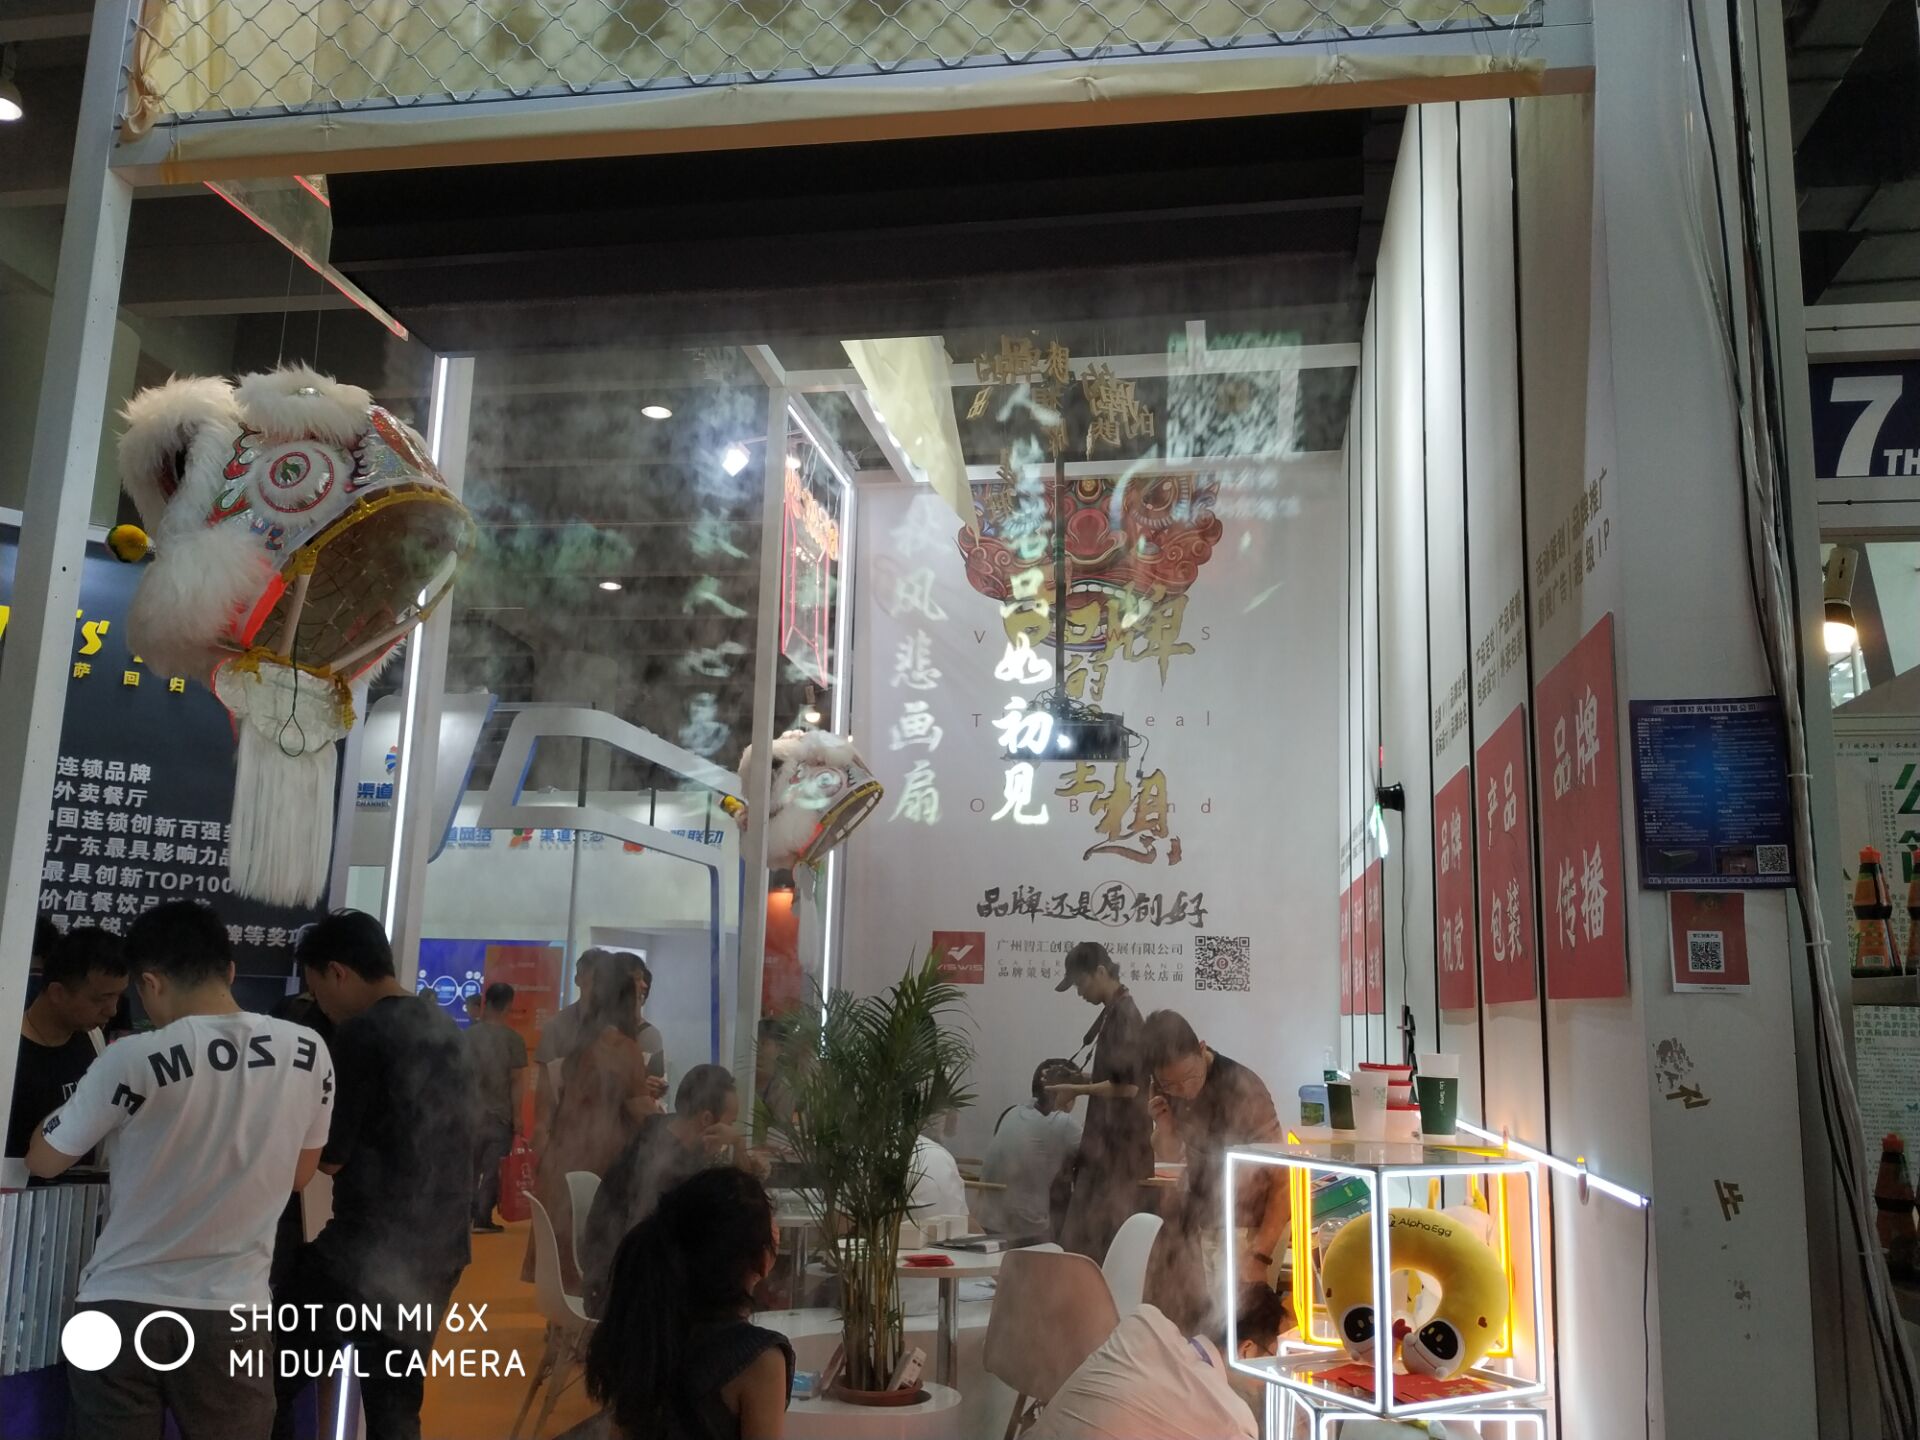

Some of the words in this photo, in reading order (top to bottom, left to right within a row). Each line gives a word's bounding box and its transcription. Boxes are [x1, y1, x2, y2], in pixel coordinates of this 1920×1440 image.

[57, 756, 151, 784] 连锁品牌
[48, 806, 232, 844] 国连锁创新百强
